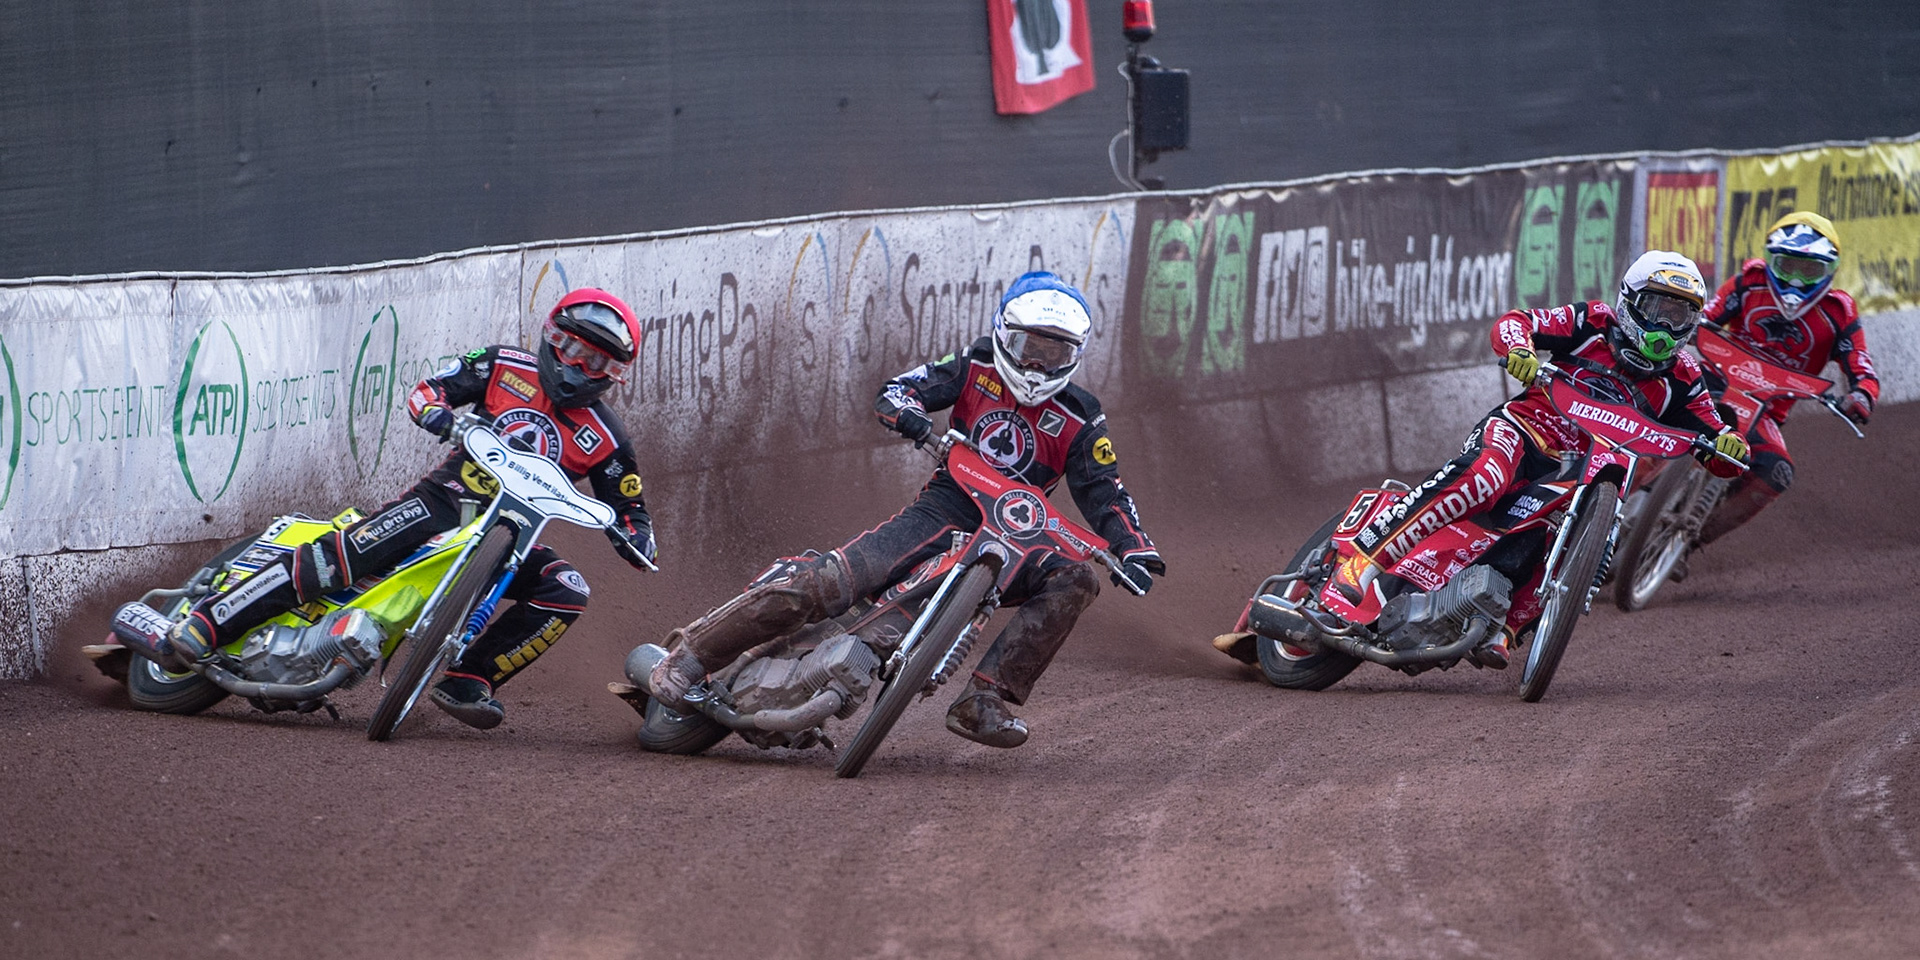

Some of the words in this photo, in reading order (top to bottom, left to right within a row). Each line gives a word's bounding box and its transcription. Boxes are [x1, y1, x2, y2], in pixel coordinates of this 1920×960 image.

[1335, 234, 1512, 347] bike-right.com
[502, 371, 538, 398] HYCOTE
[188, 384, 238, 436] ATPI
[1568, 401, 1639, 434] MERIDIAN
[1641, 421, 1678, 452] LIFTS
[501, 413, 531, 425] BELLE
[534, 416, 550, 432] VUE
[548, 433, 558, 459] ACES
[578, 429, 598, 448] 5
[979, 412, 1003, 429] BELLE
[1022, 428, 1033, 450] ACES
[508, 461, 531, 480] Billig
[1343, 494, 1378, 530] 5
[1384, 457, 1505, 563] MERIDIAN
[357, 525, 384, 545] Claus
